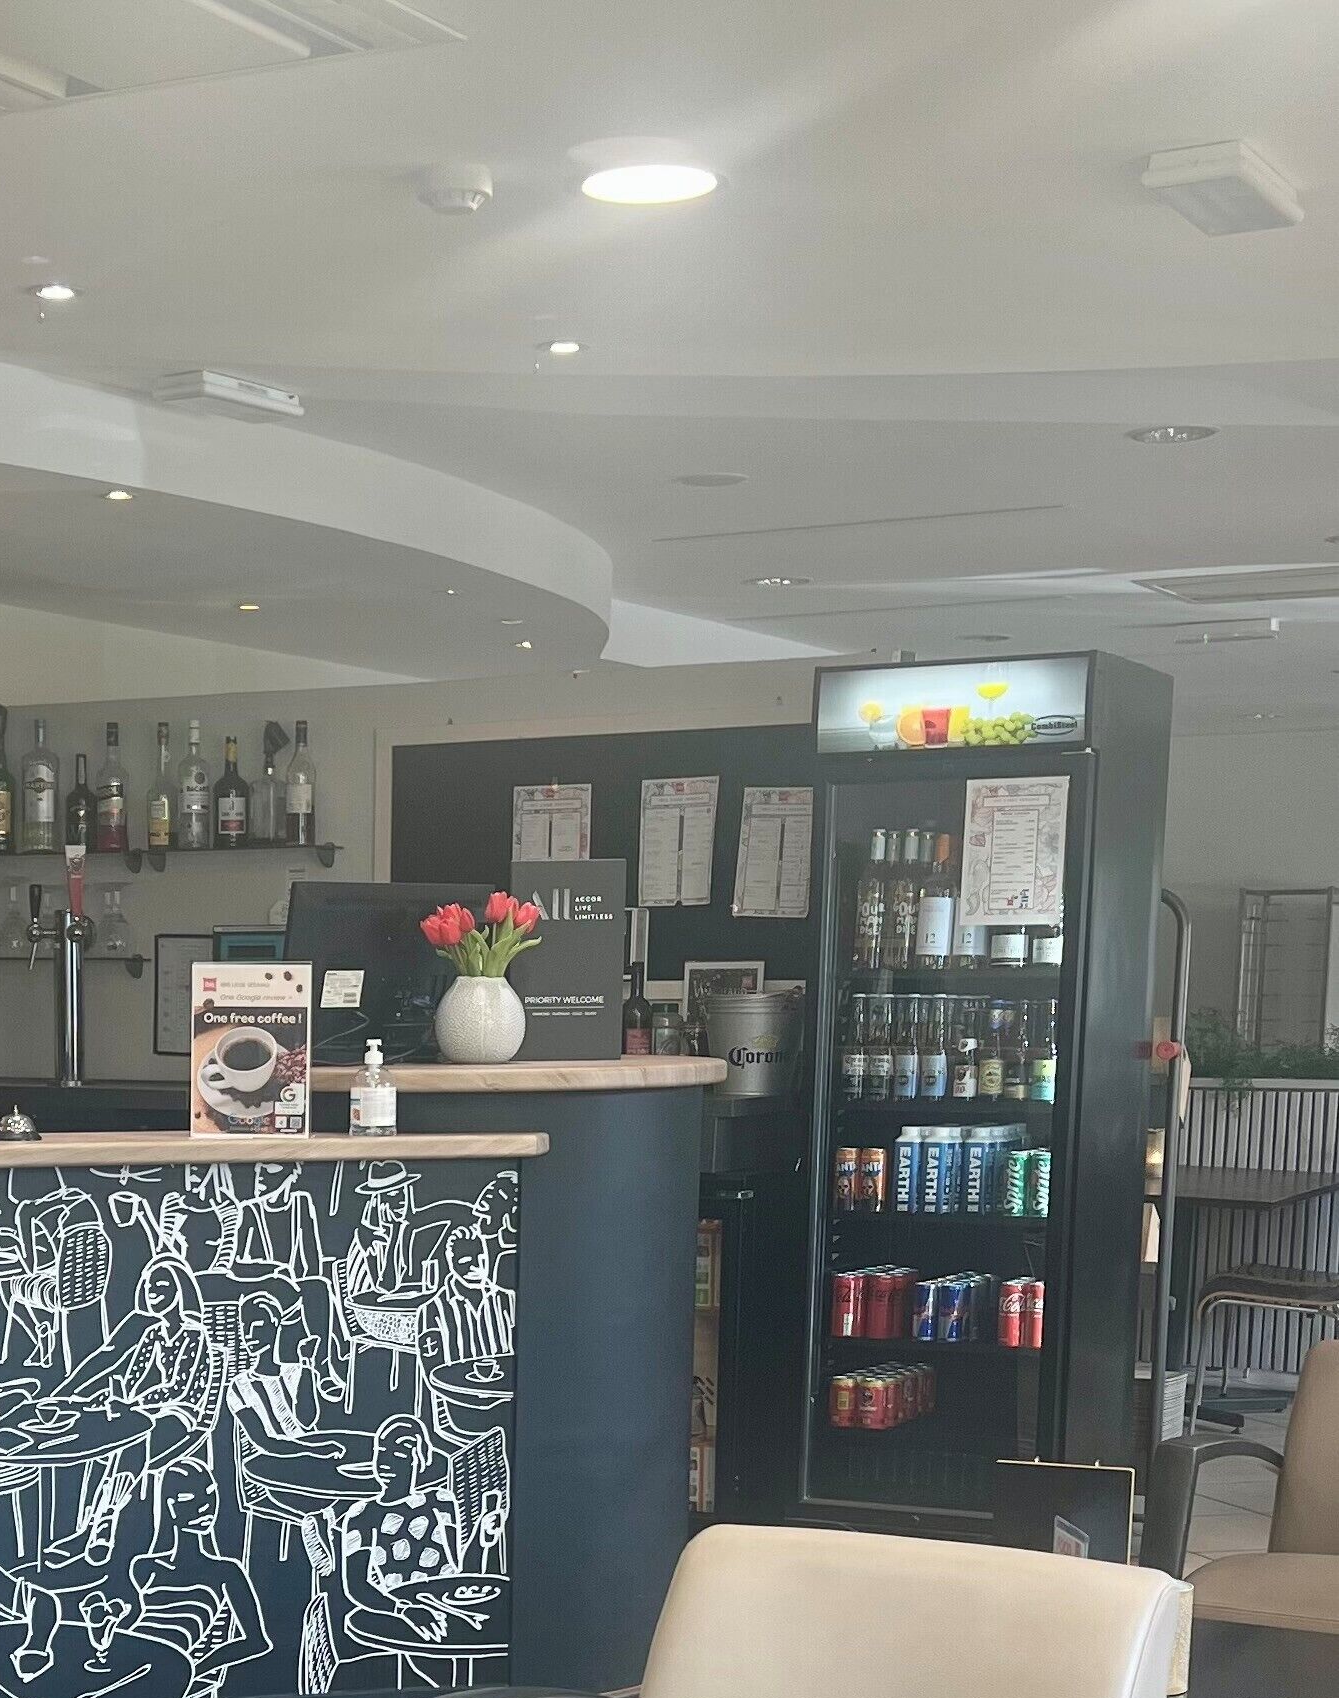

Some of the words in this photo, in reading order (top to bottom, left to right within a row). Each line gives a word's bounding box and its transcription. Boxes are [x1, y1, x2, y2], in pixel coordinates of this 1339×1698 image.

[574, 895, 602, 903] ACCOR
[574, 904, 592, 912] LIVE
[524, 995, 561, 1004] PRIORITY
[562, 995, 605, 1004] WELCOME
[203, 1012, 228, 1024] One
[230, 1012, 256, 1024] free
[257, 1012, 296, 1024] coffee
[728, 1046, 791, 1070] Coron
[897, 1146, 912, 1202] EARTH
[924, 1147, 940, 1203] EARTH
[967, 1147, 982, 1203] EARTH
[1003, 1159, 1024, 1215] Sprite
